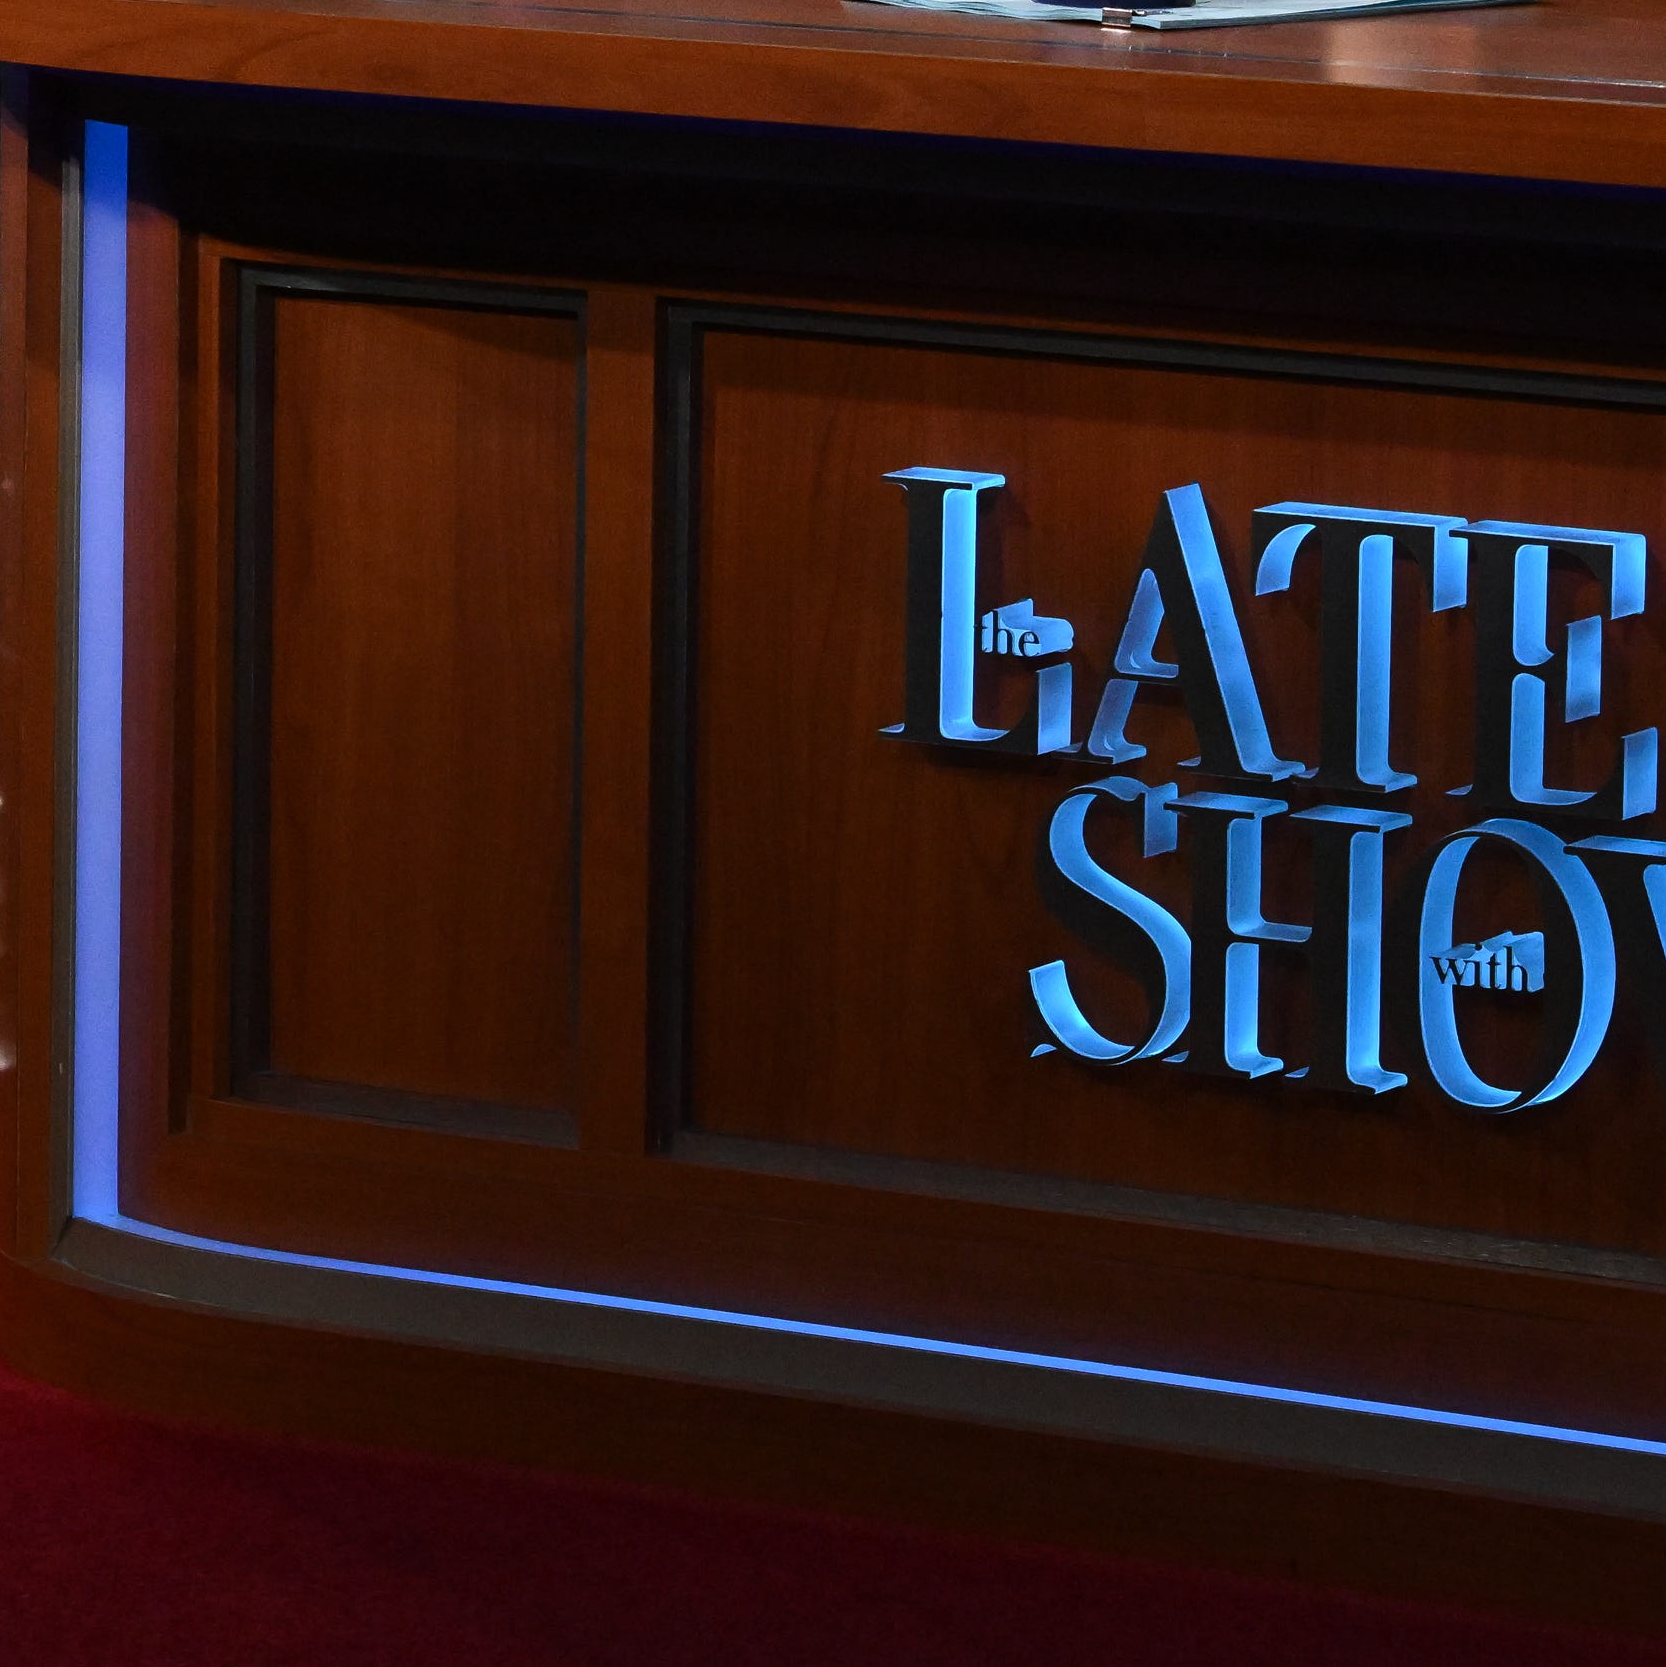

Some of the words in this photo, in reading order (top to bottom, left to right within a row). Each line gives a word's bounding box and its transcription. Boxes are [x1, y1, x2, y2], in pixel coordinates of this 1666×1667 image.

[877, 464, 1659, 821] LATE
[972, 608, 1042, 659] the
[1427, 941, 1531, 994] with
